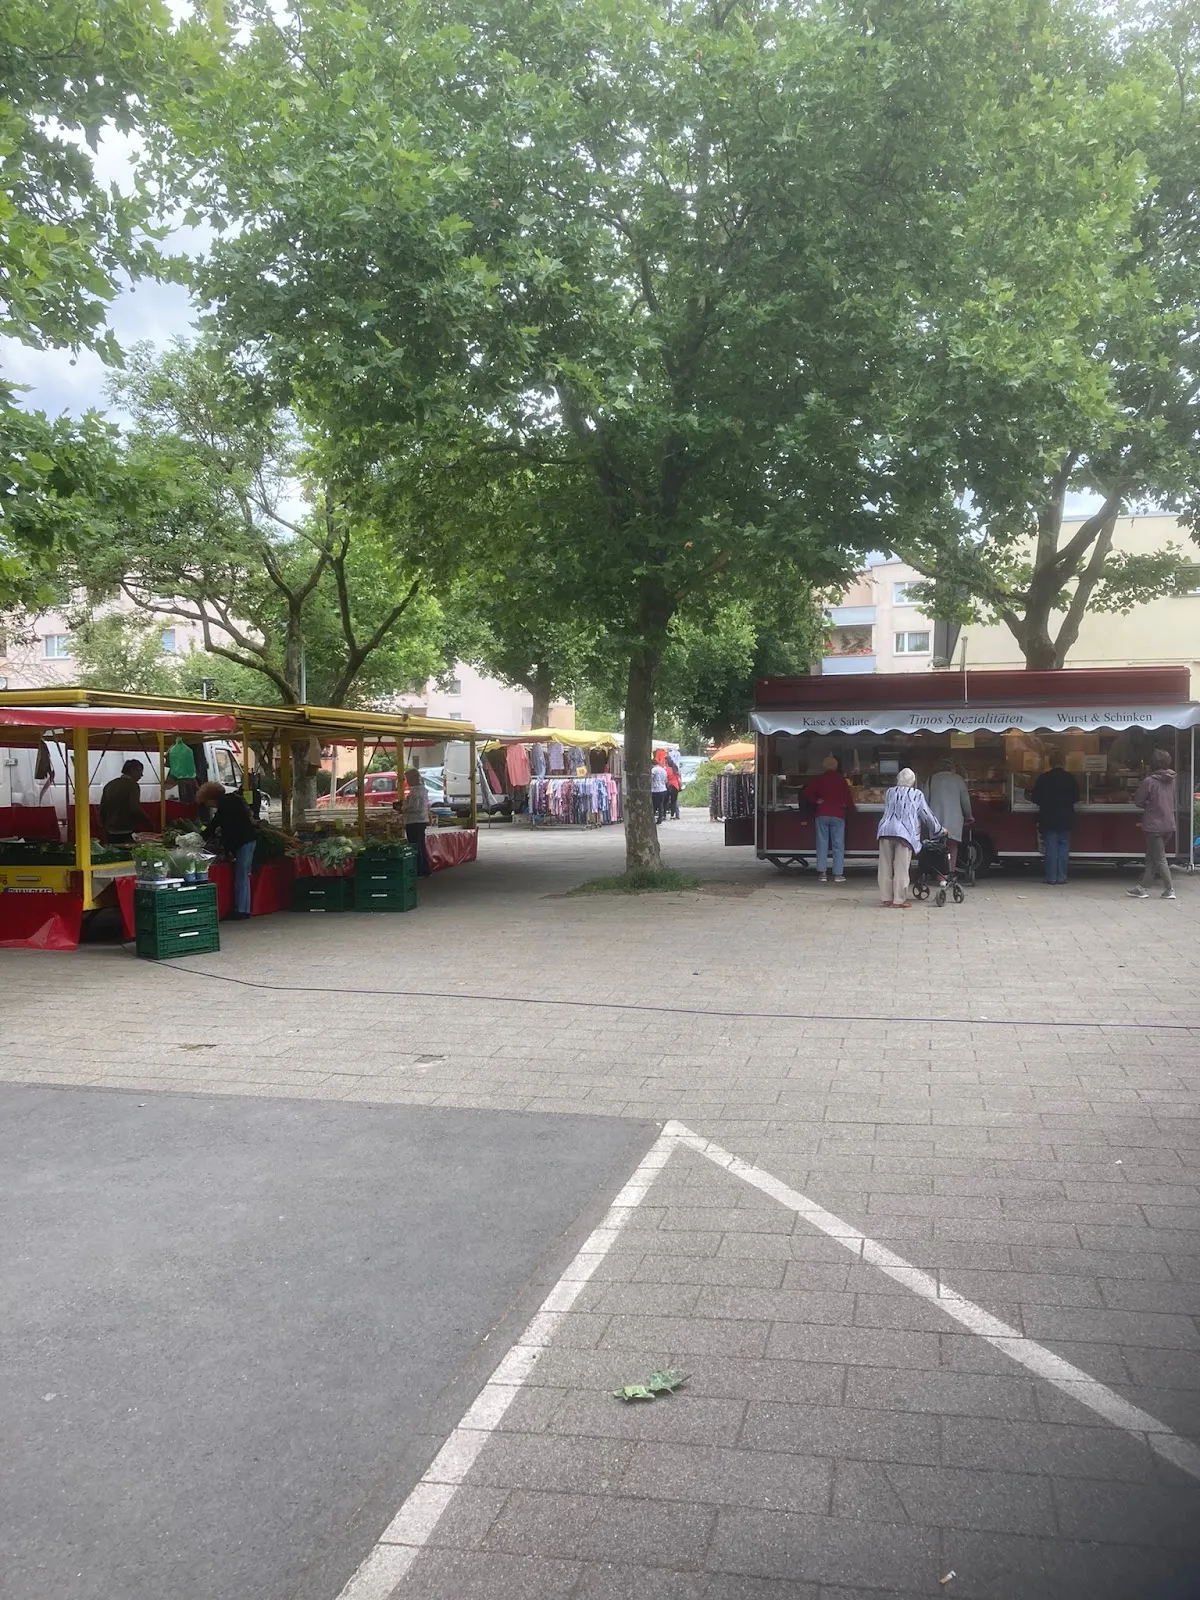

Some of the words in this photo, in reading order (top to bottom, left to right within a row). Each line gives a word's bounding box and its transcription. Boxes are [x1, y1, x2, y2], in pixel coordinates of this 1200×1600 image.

[828, 717, 837, 726] &
[840, 716, 870, 726] Salate
[909, 714, 943, 725] Timos
[946, 713, 1023, 727] Spezialitäten
[1057, 713, 1087, 723] Wurst
[1091, 713, 1100, 723] &
[1104, 712, 1152, 722] Schinken
